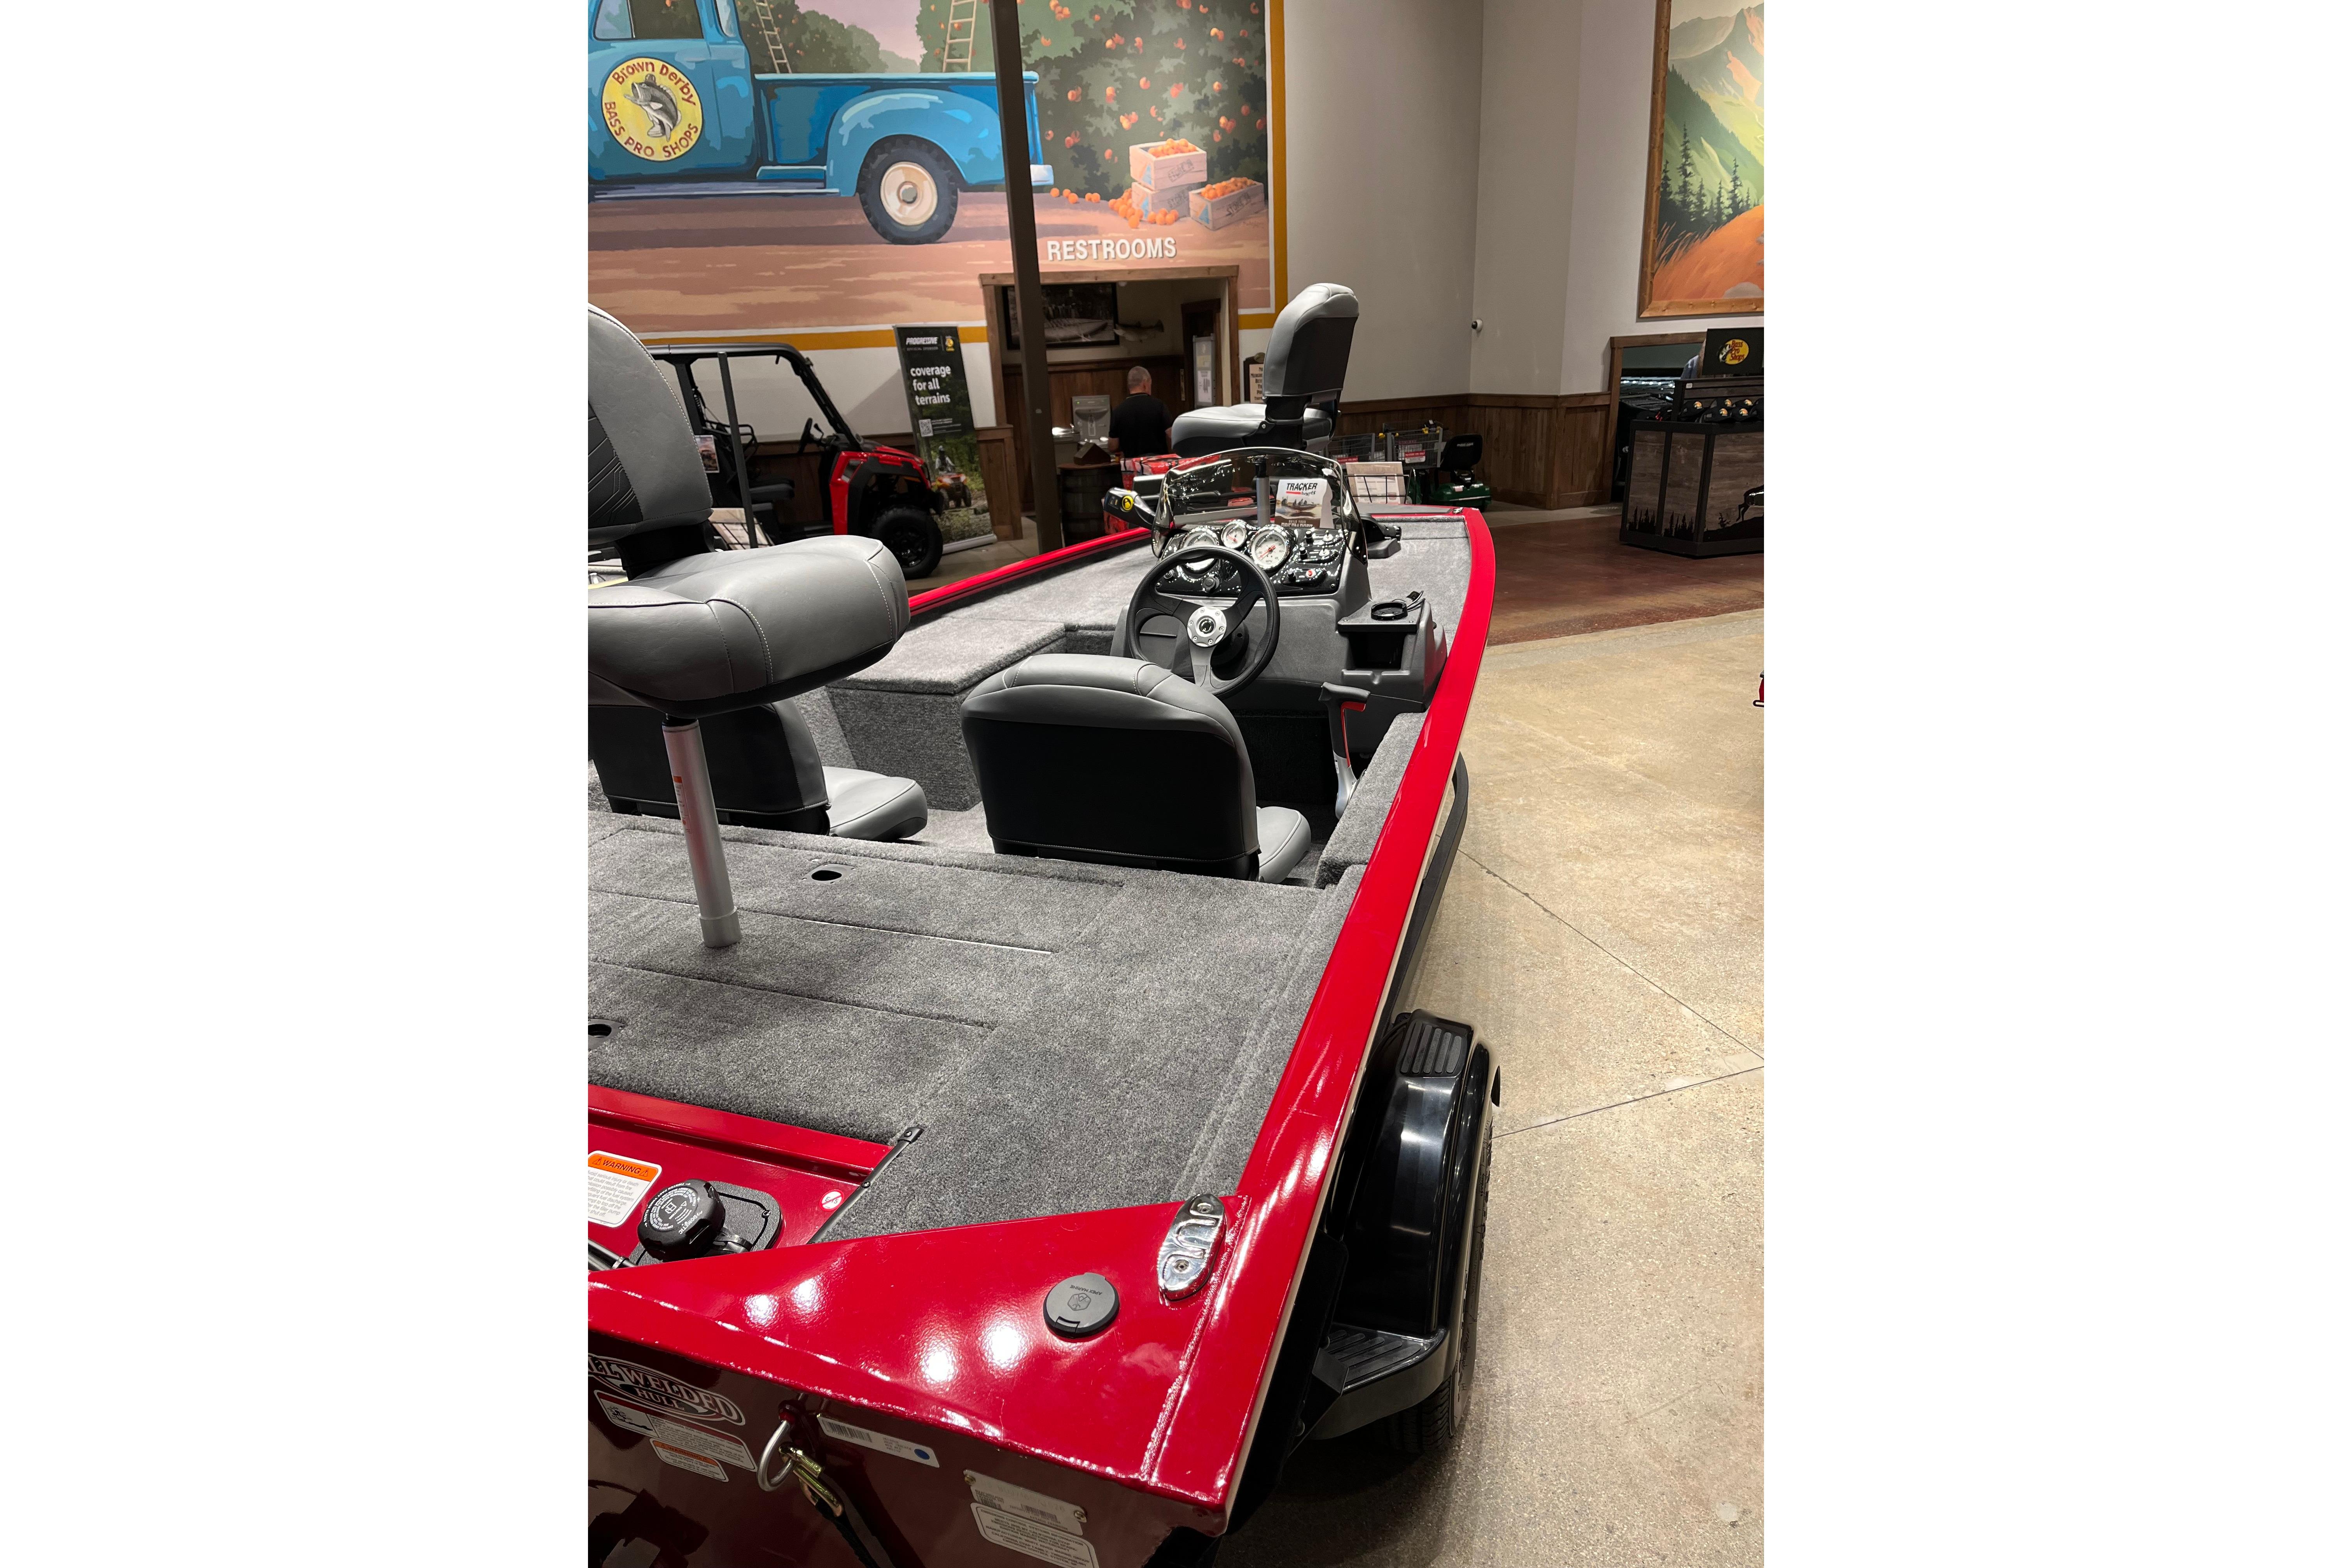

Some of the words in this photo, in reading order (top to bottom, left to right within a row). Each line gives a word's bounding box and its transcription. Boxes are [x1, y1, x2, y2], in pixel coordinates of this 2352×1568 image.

[612, 61, 655, 85] Brown
[660, 64, 696, 106] Derby
[604, 102, 625, 136] BASS
[624, 136, 654, 157] PRO
[663, 123, 698, 158] SHOPS
[1047, 237, 1177, 261] RESTROOMS
[910, 366, 952, 377] coverage
[912, 379, 928, 391] for
[928, 378, 940, 390] all
[915, 392, 950, 405] terrains
[603, 1160, 641, 1174] WARNING
[679, 1215, 698, 1234] DOMETIC
[622, 1367, 738, 1420] WELDED
[636, 1388, 685, 1410] HULL
